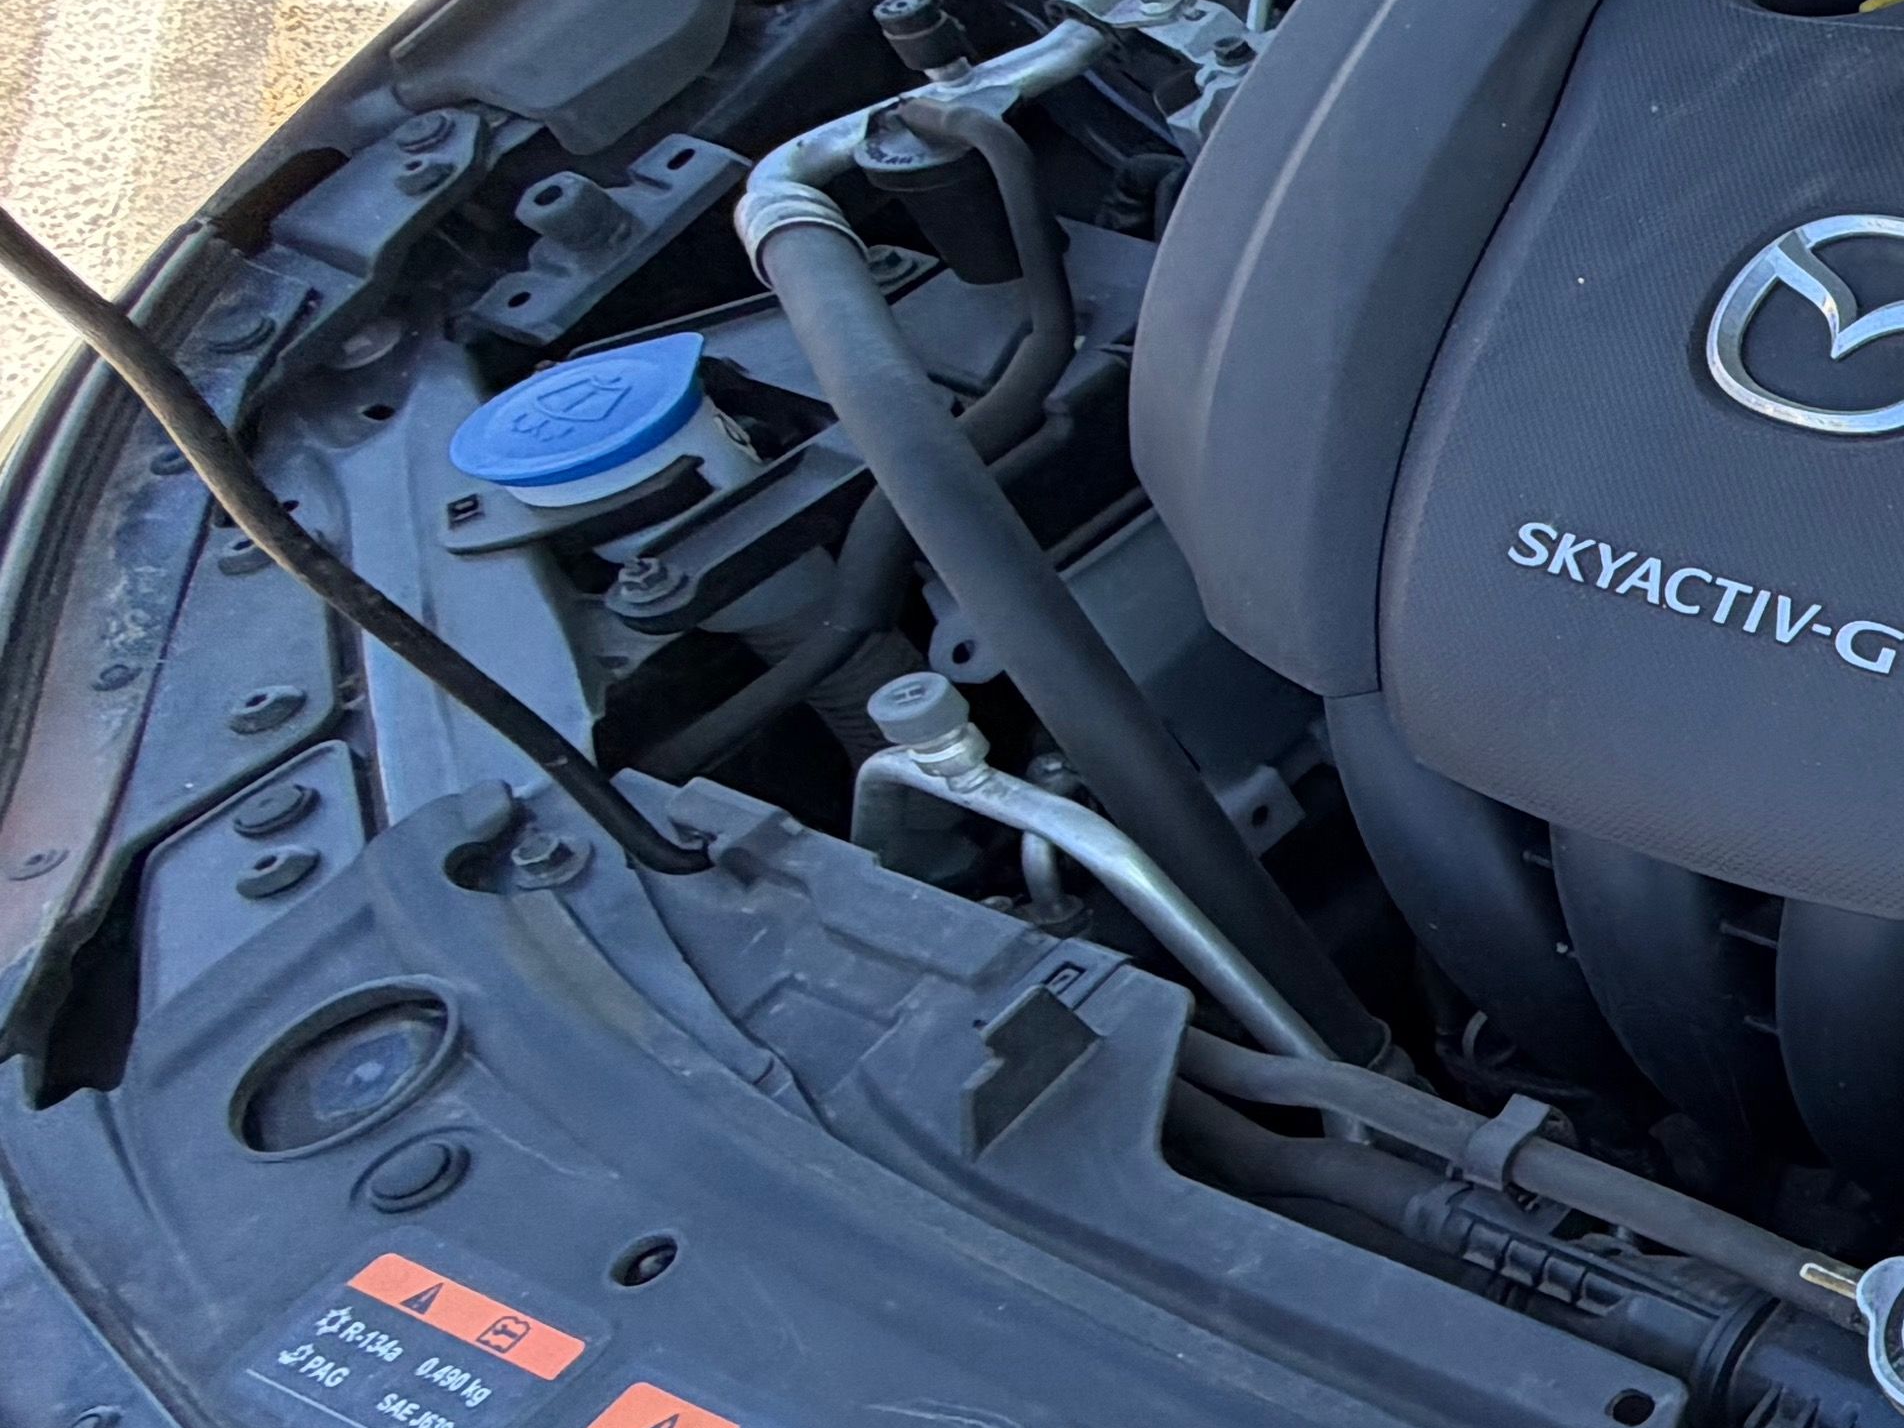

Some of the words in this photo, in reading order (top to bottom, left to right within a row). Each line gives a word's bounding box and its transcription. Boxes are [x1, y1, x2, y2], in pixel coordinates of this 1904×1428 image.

[299, 1355, 351, 1388] PAG
[375, 1393, 416, 1422] SAE
[339, 1321, 404, 1363] R-134a
[414, 1357, 472, 1394] 0.490
[461, 1378, 493, 1408] kg
